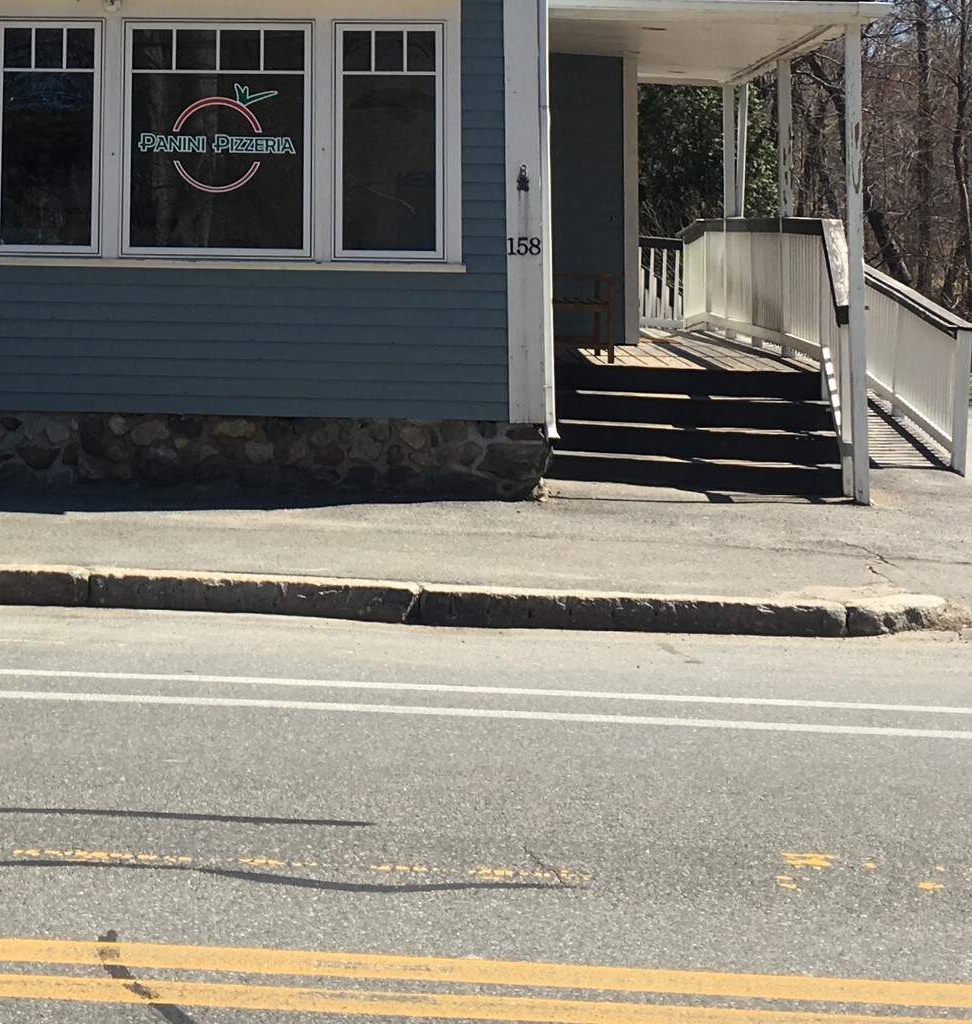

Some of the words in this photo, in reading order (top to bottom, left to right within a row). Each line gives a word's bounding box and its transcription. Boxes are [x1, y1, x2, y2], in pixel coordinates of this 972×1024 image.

[138, 133, 207, 153] PANINI
[212, 134, 296, 154] PIZZERIA
[507, 236, 541, 256] 158
